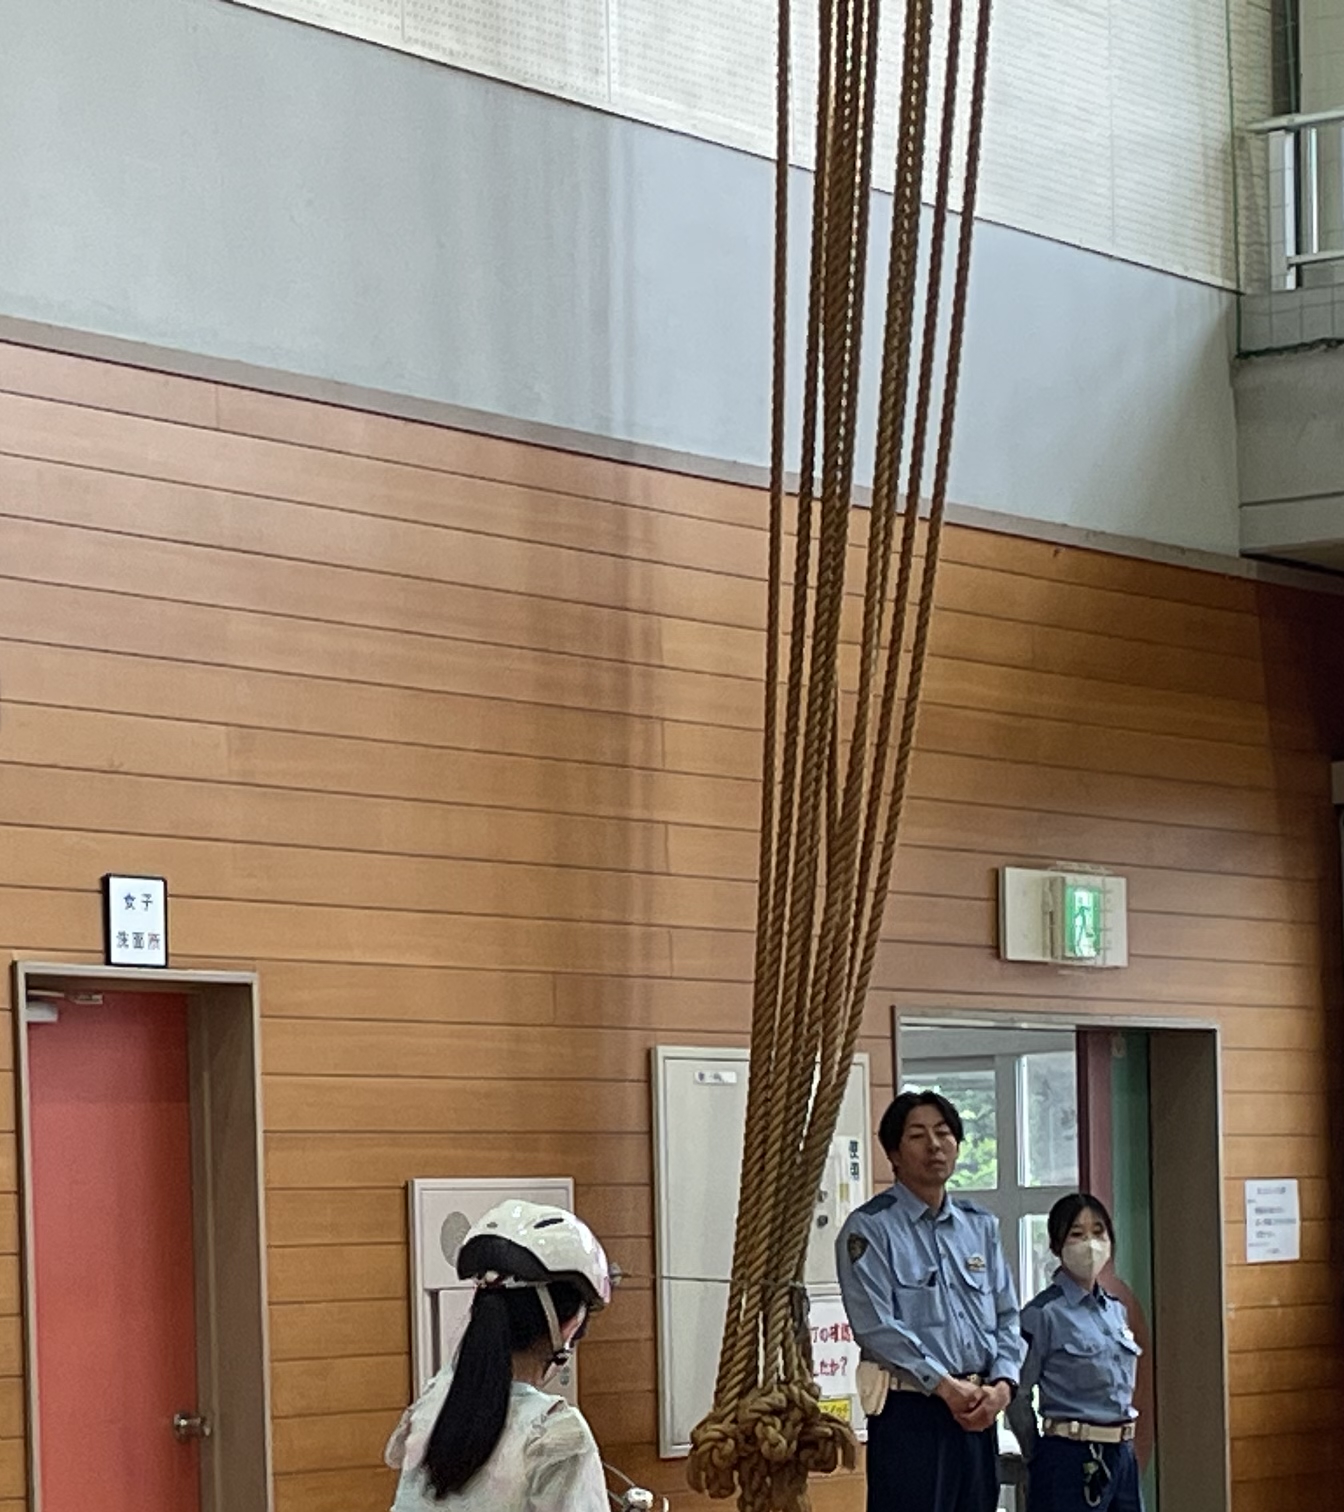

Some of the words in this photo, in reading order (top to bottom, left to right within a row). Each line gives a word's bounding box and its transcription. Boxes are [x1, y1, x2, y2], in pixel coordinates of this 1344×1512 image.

[123, 892, 153, 911] 女子
[116, 931, 160, 950] 洗面所
